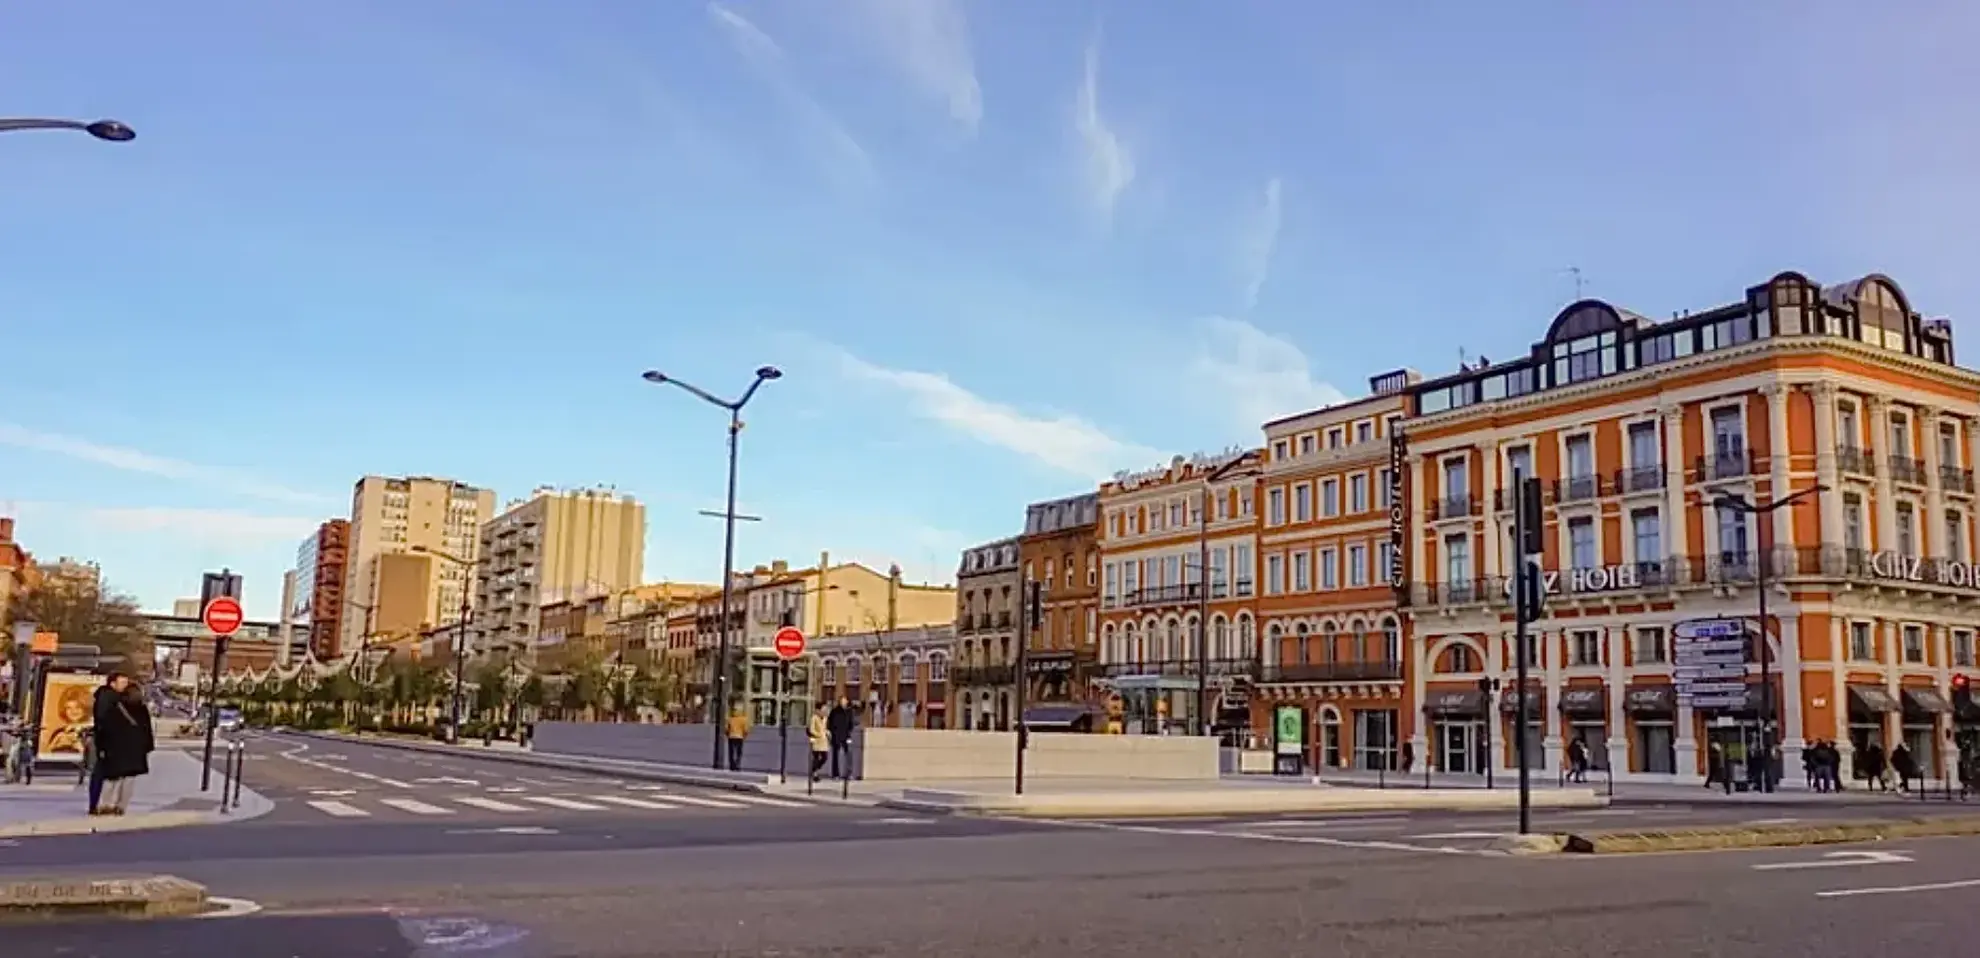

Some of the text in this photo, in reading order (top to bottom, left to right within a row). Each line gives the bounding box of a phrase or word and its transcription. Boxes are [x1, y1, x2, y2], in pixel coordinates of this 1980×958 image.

[1391, 481, 1403, 588] CITIZ HOTEL
[1571, 564, 1641, 592] HOTEL
